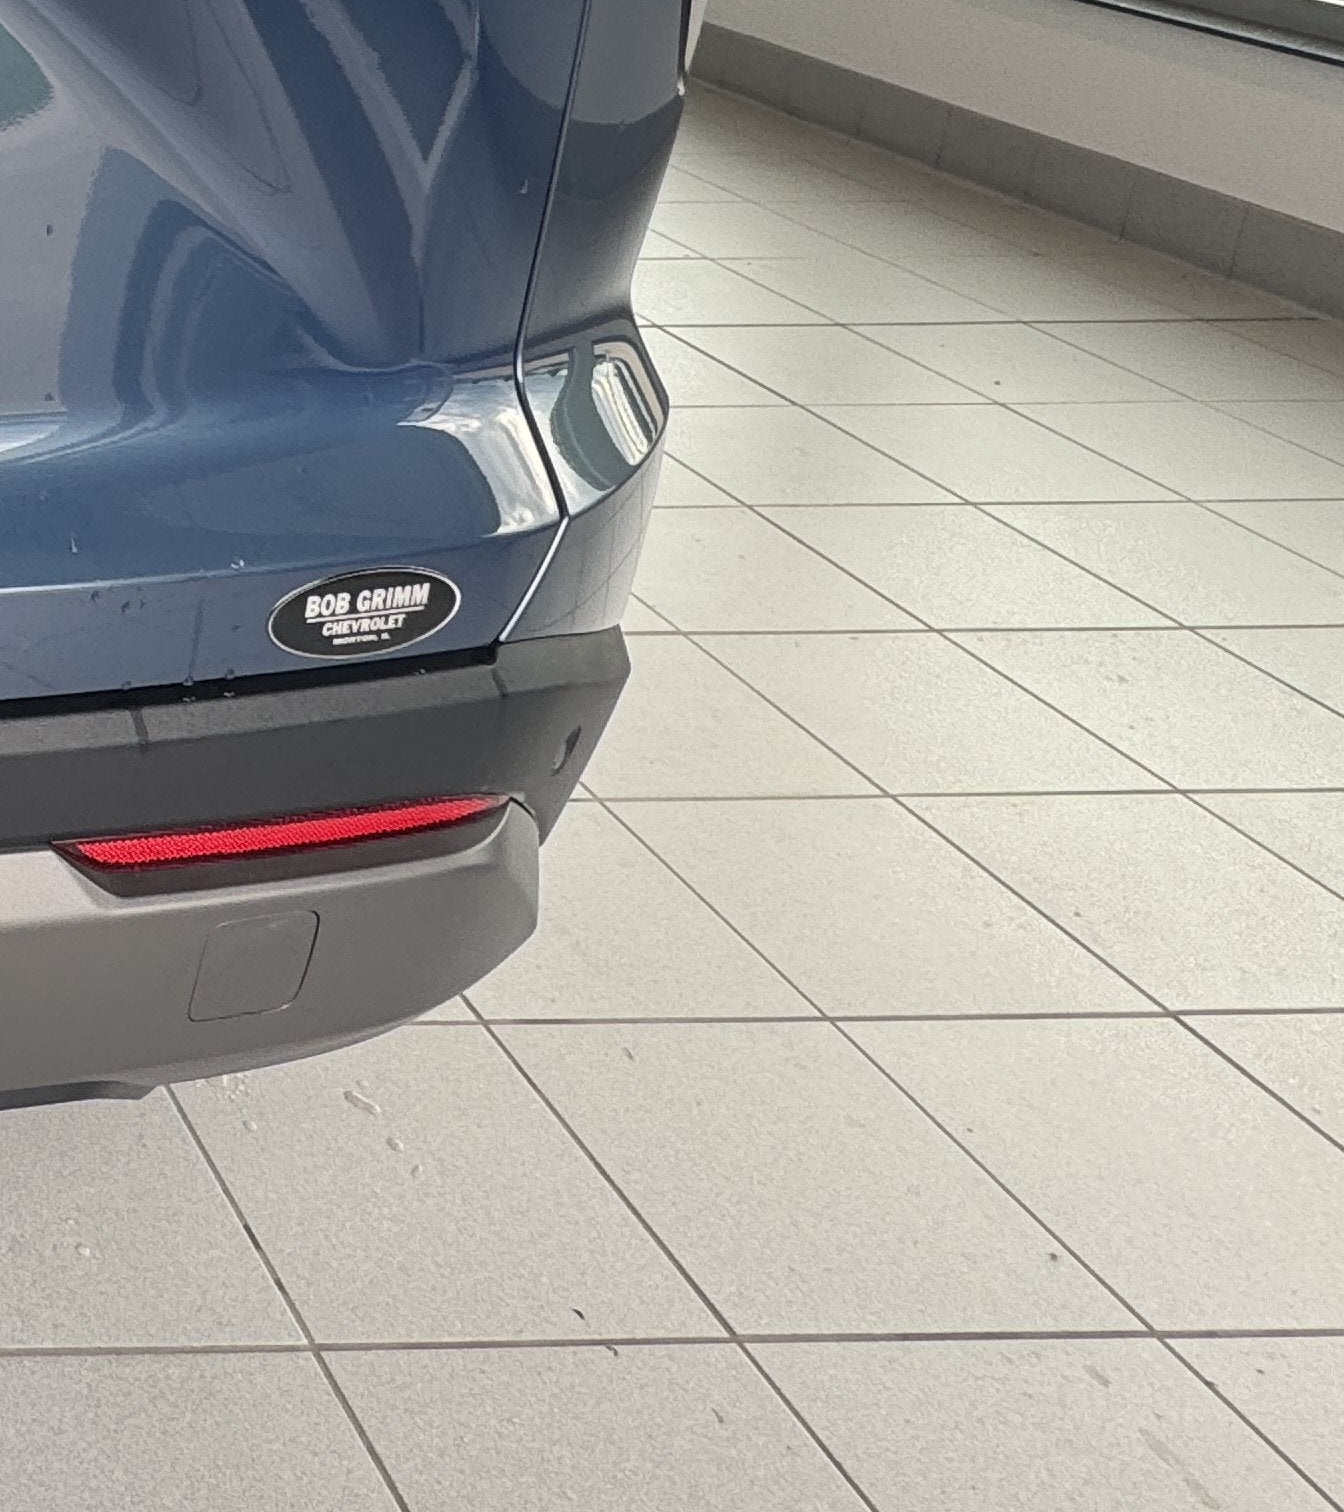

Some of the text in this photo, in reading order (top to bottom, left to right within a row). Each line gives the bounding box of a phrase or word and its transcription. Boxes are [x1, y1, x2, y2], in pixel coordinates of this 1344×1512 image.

[304, 583, 431, 618] BOB GRIMM
[322, 614, 406, 636] CHEVROLET
